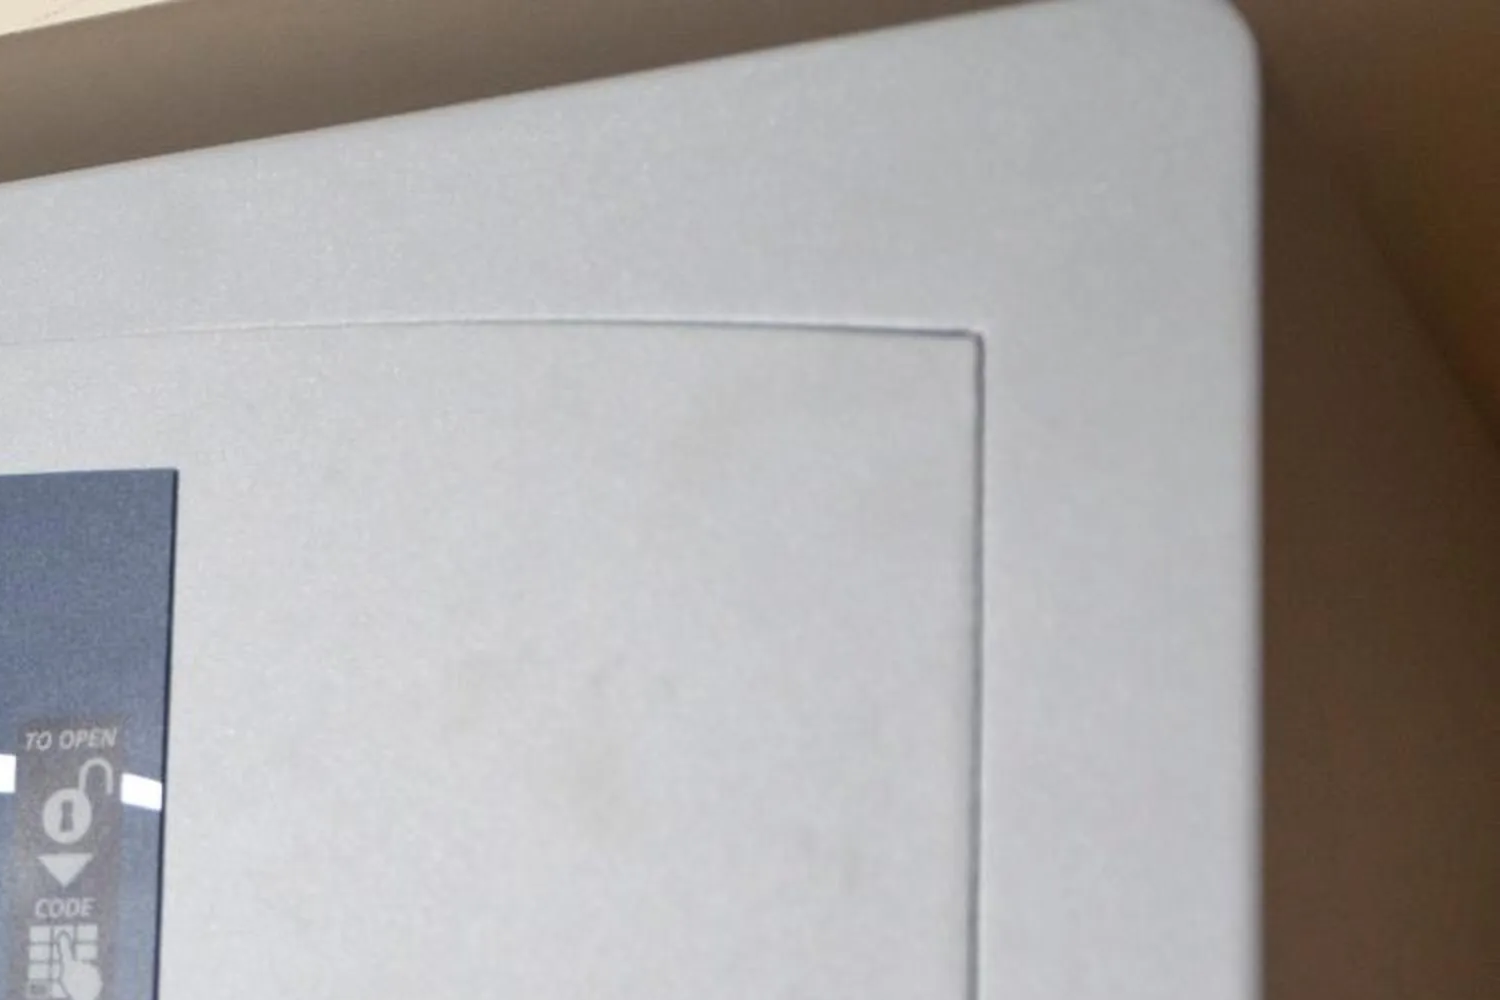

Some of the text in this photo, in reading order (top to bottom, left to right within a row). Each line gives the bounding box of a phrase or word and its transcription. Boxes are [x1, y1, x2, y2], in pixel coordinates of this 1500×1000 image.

[25, 726, 118, 751] TO OPEN
[35, 897, 95, 919] CODE
